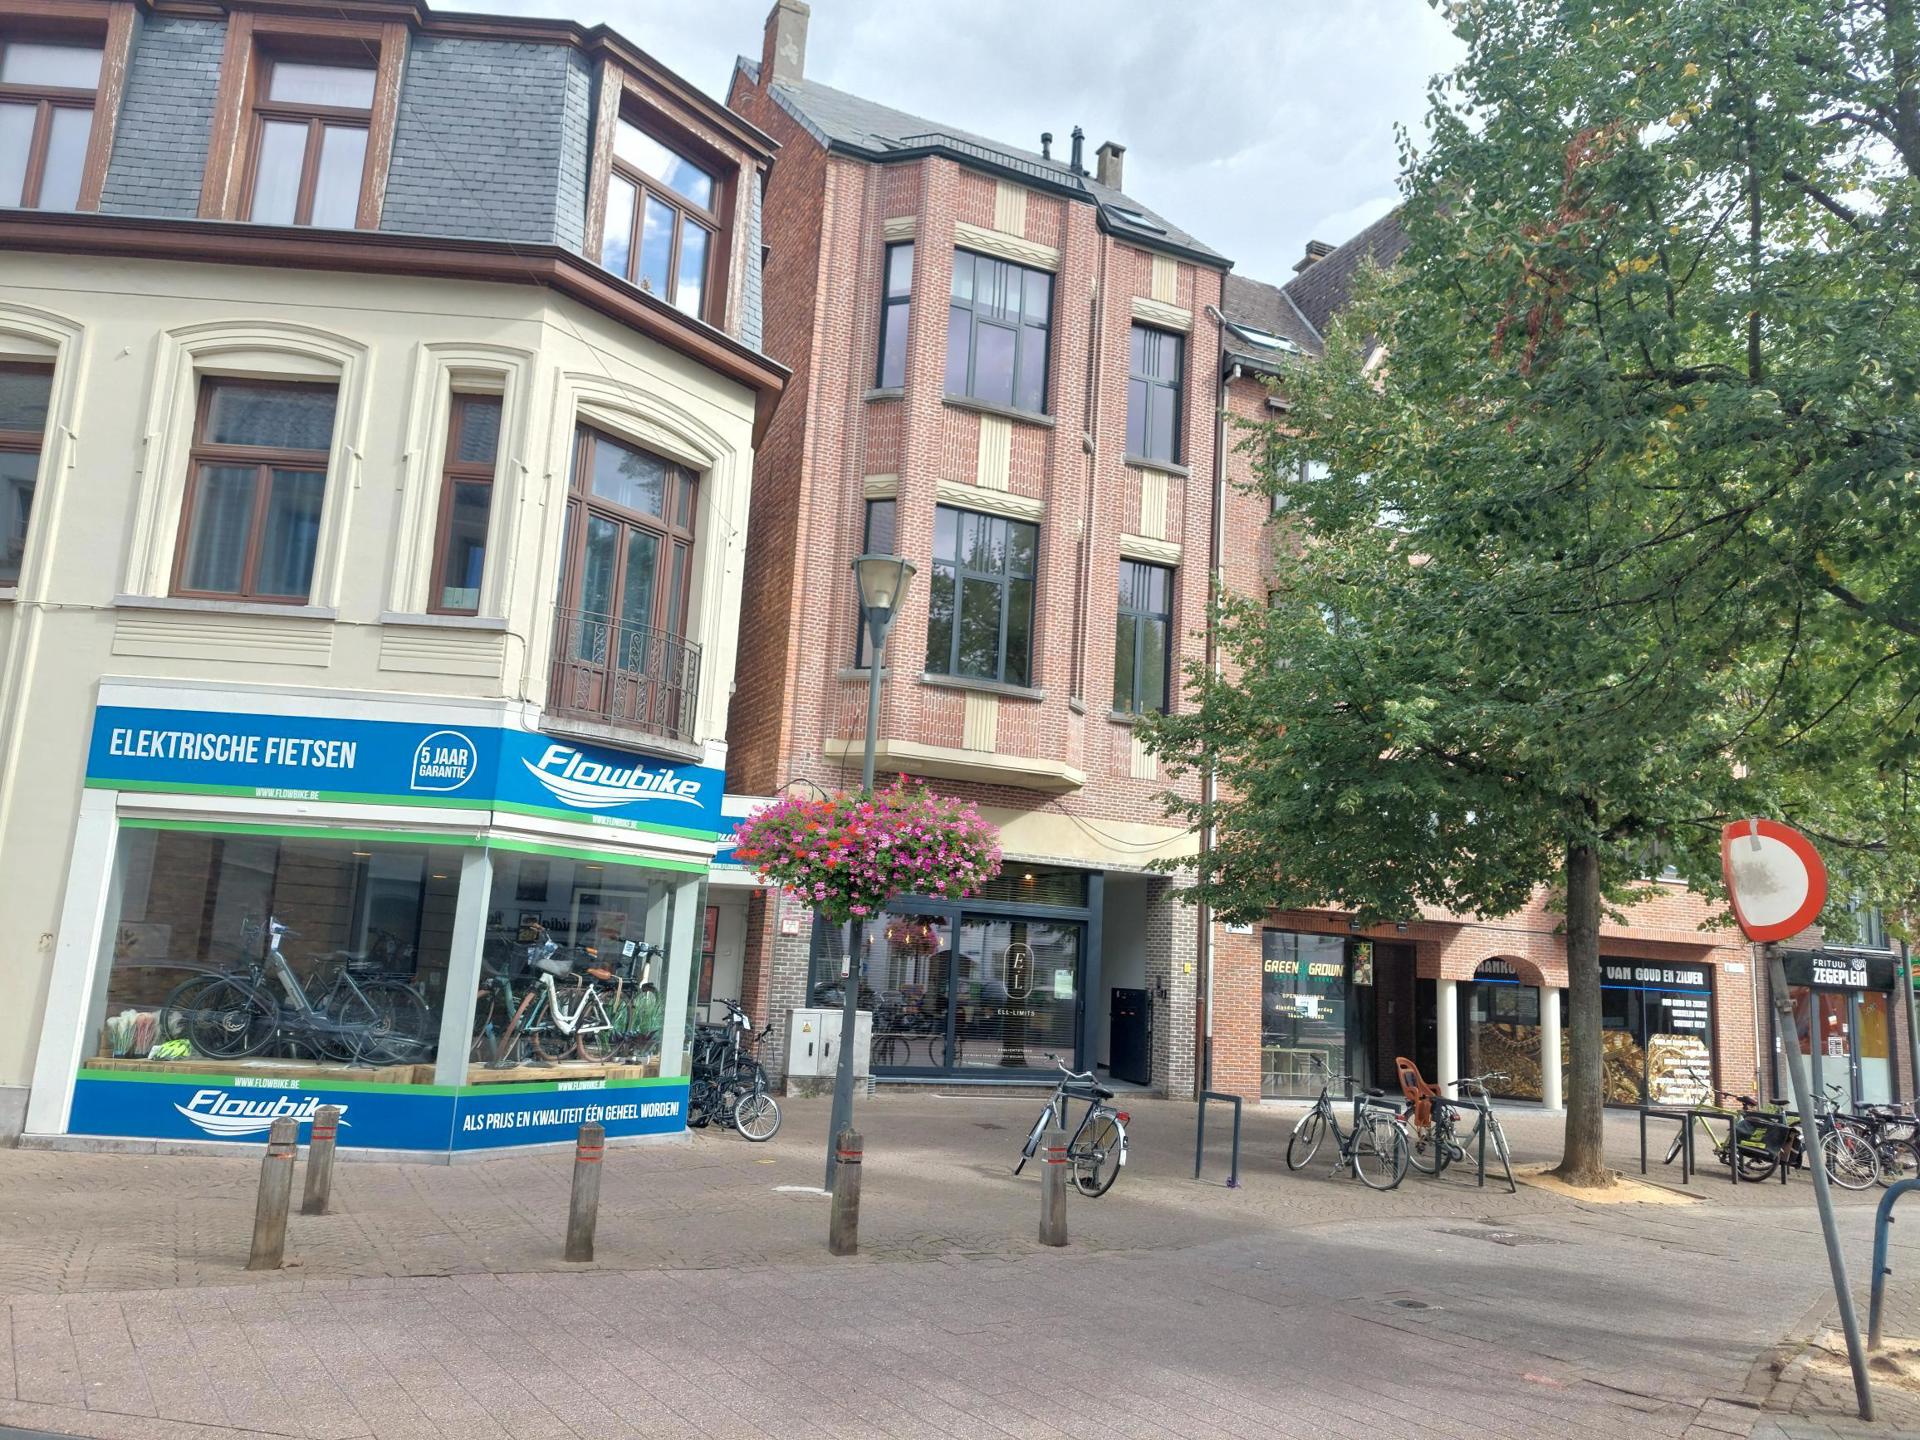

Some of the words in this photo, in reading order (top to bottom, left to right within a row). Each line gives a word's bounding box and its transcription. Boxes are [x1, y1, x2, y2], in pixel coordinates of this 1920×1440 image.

[109, 728, 261, 763] ELEKTRISCHE
[264, 737, 357, 769] FIETSEN
[420, 746, 431, 764] 5
[432, 747, 468, 766] JAAR
[419, 764, 467, 779] GARANTIE
[537, 744, 702, 799] Flowbike
[255, 787, 320, 801] WWW.FLOWBIKE.BE
[1264, 959, 1300, 974] GREEN
[1308, 962, 1344, 977] GROWN
[1606, 966, 1632, 980] VAN
[1635, 967, 1661, 982] GOUD
[1663, 969, 1674, 983] EN
[1675, 970, 1704, 985] ZILVER
[1813, 967, 1868, 987] ZEGEPLEIN
[997, 1008, 1036, 1017] ELL-LIMITS
[234, 1077, 301, 1089] WWW.FLOWBIKE.BE
[463, 1113, 484, 1131] ALS
[486, 1111, 514, 1130] PRIJS
[516, 1110, 531, 1127] EN
[532, 1107, 584, 1126] KWALITEIT
[584, 1104, 603, 1122] ÉÉN
[605, 1103, 639, 1121] GEHEEL
[640, 1101, 680, 1118] WORDEN!
